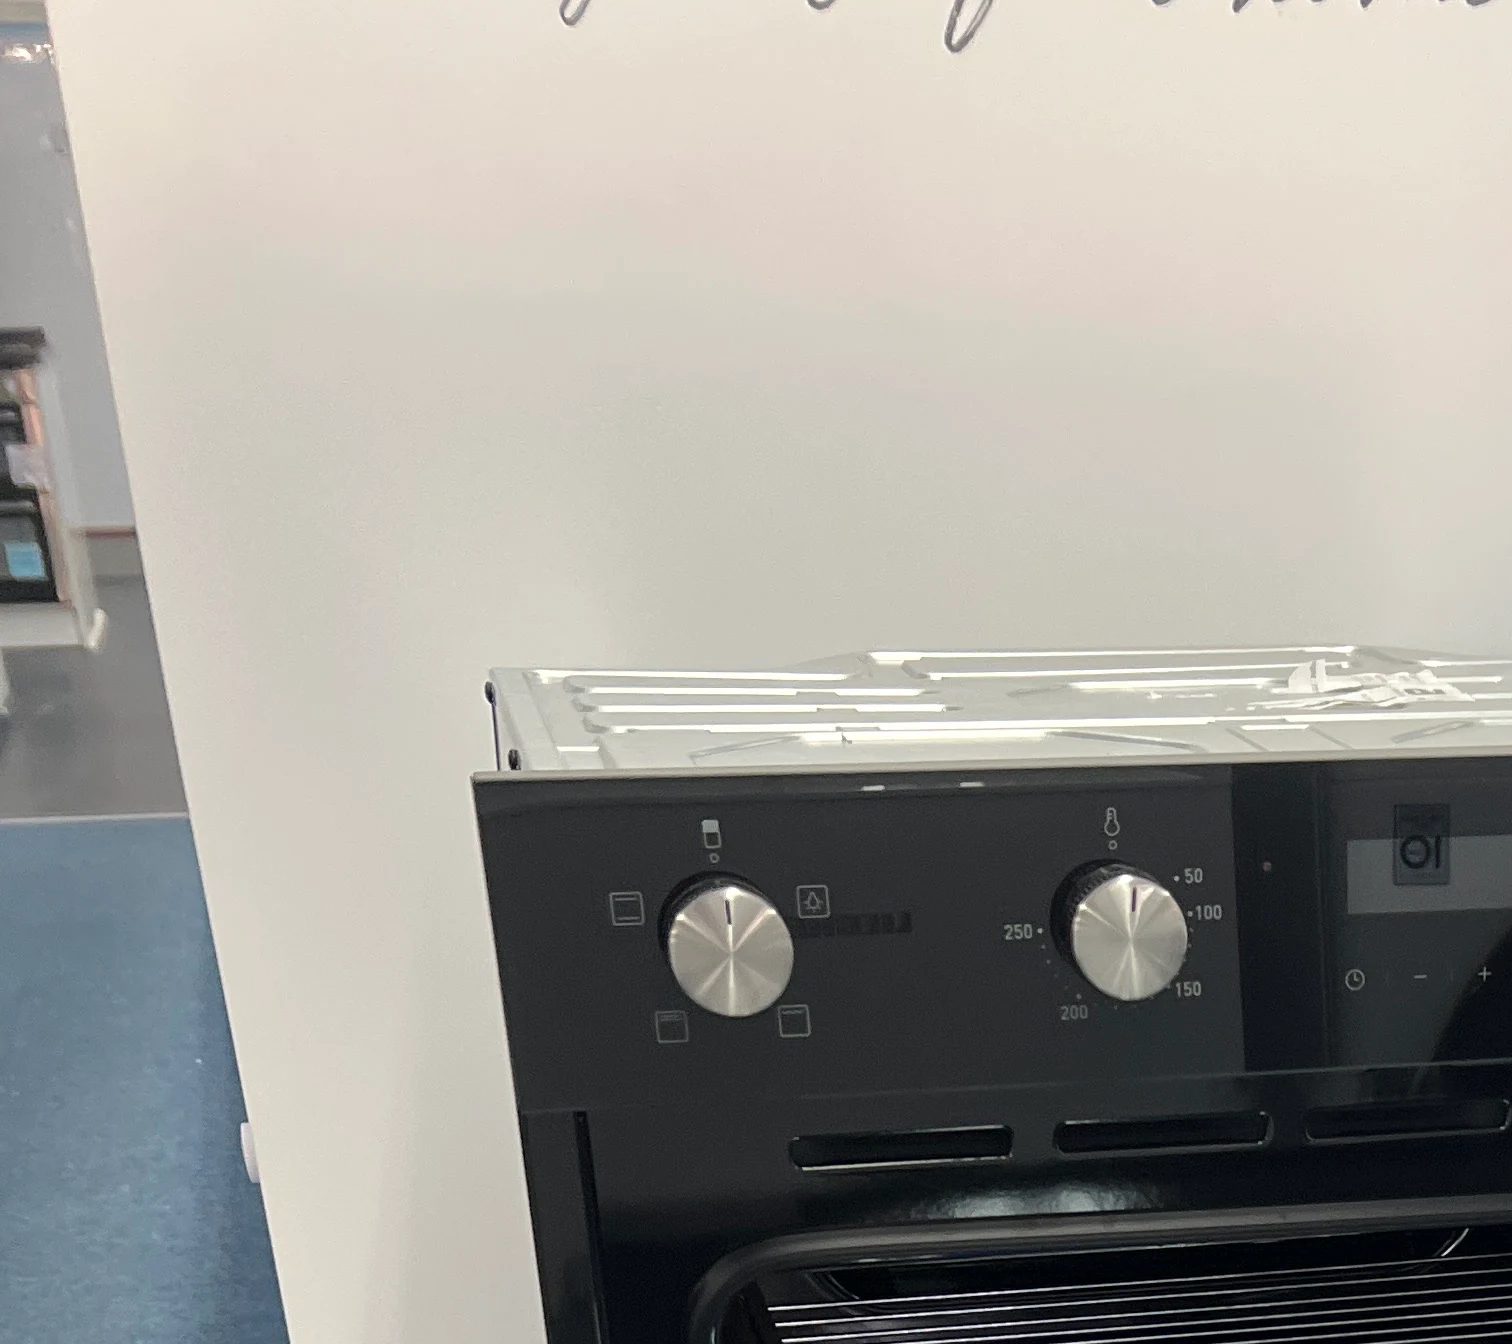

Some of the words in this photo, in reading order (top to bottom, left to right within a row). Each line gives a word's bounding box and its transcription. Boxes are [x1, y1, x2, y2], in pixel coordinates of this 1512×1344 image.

[1184, 868, 1203, 884] 50
[1195, 904, 1222, 920] 100
[1003, 923, 1033, 941] 250
[1175, 981, 1202, 998] 150
[1061, 1004, 1088, 1021] 200
